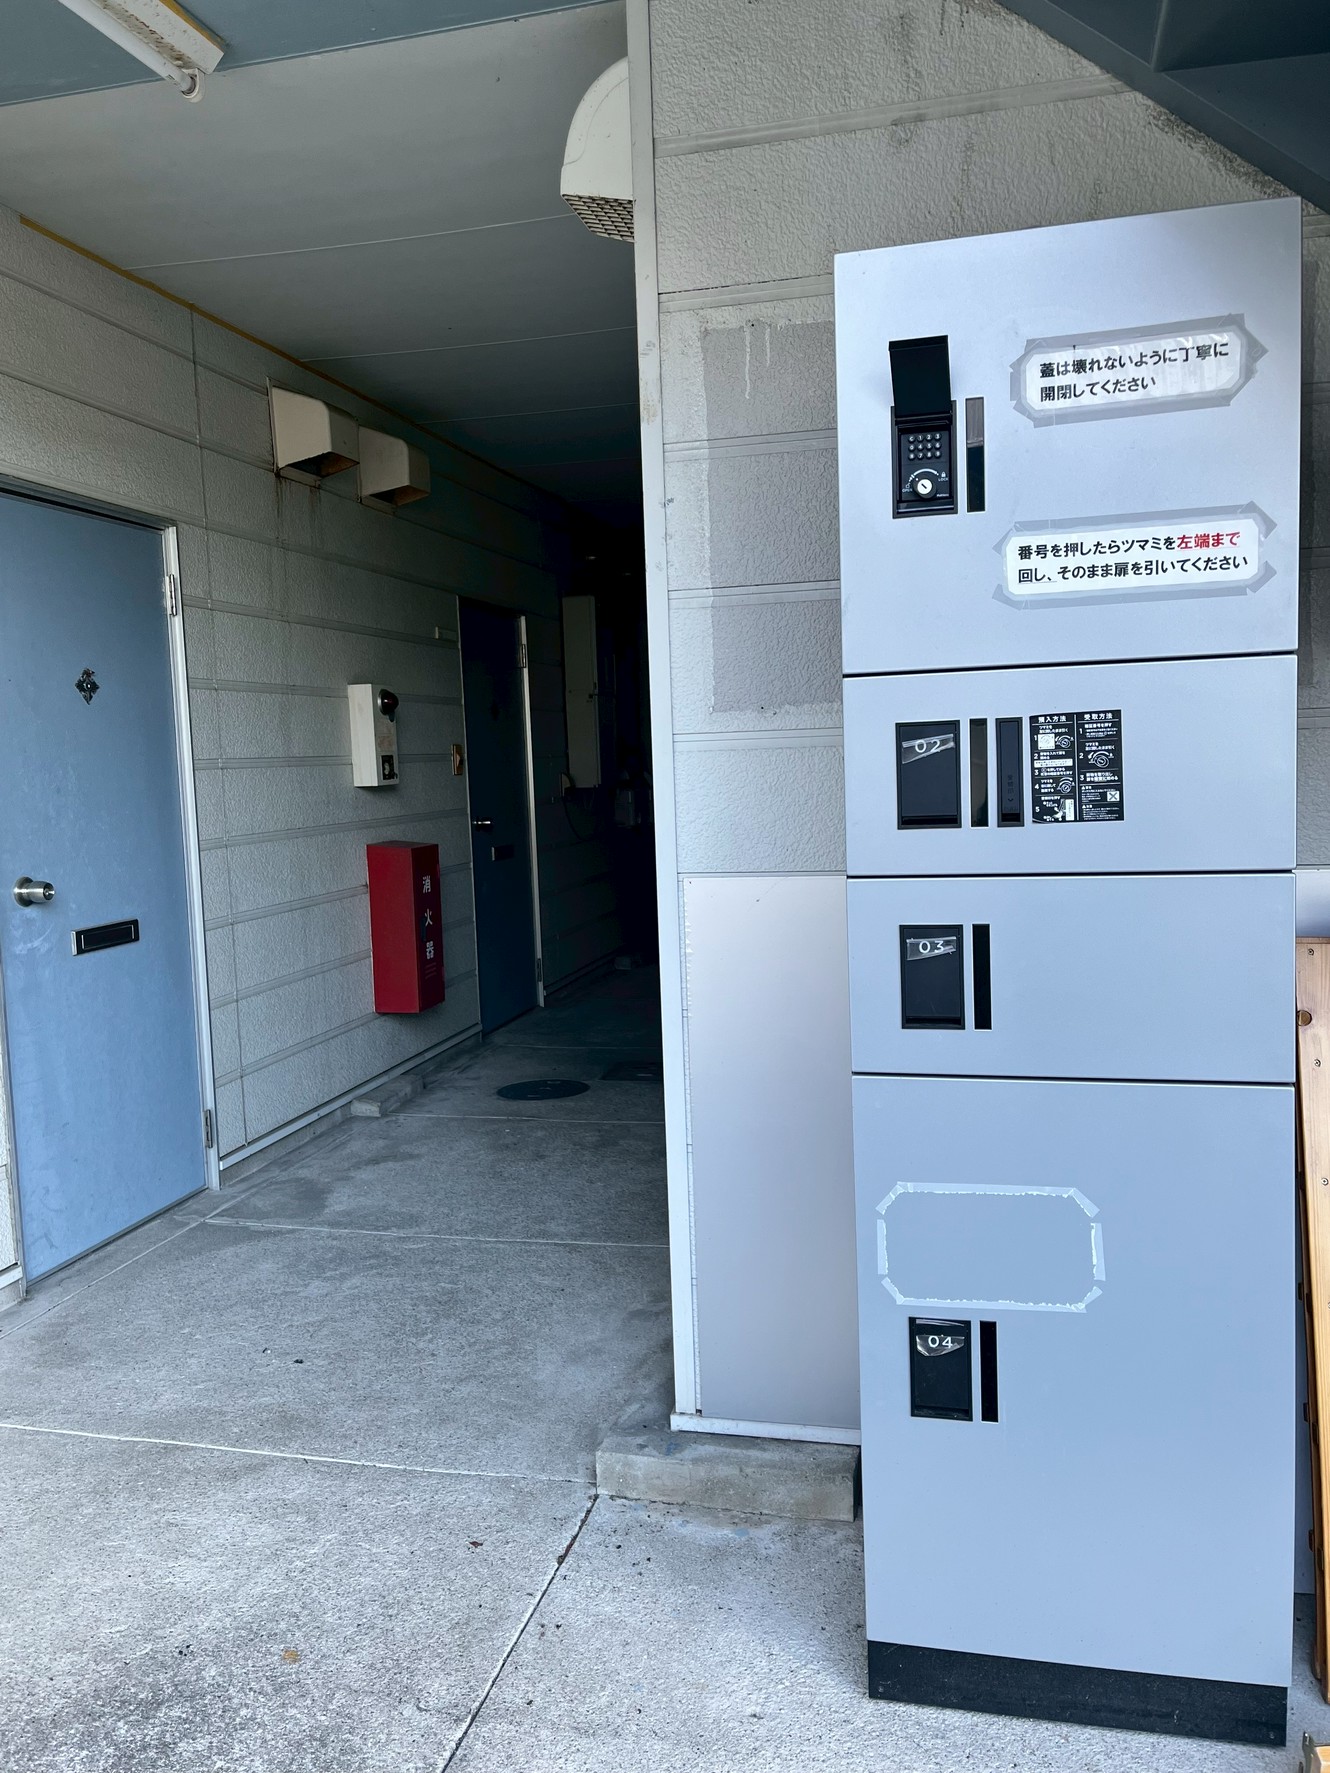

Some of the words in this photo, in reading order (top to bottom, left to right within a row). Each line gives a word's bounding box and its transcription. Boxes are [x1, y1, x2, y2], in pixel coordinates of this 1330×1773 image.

[1039, 343, 1229, 379] 蓋は壊れないように丁寧に
[1040, 376, 1156, 402] 開閉してください
[1018, 532, 1241, 561] 番号を押したらツマミを左端まで
[1018, 555, 1248, 584] 回し、そのまま扉を引いてください
[1084, 712, 1113, 720] 受取方法
[915, 739, 941, 753] 02
[423, 875, 435, 960] 消火器
[919, 940, 944, 954] 03
[928, 1335, 953, 1349] 04
